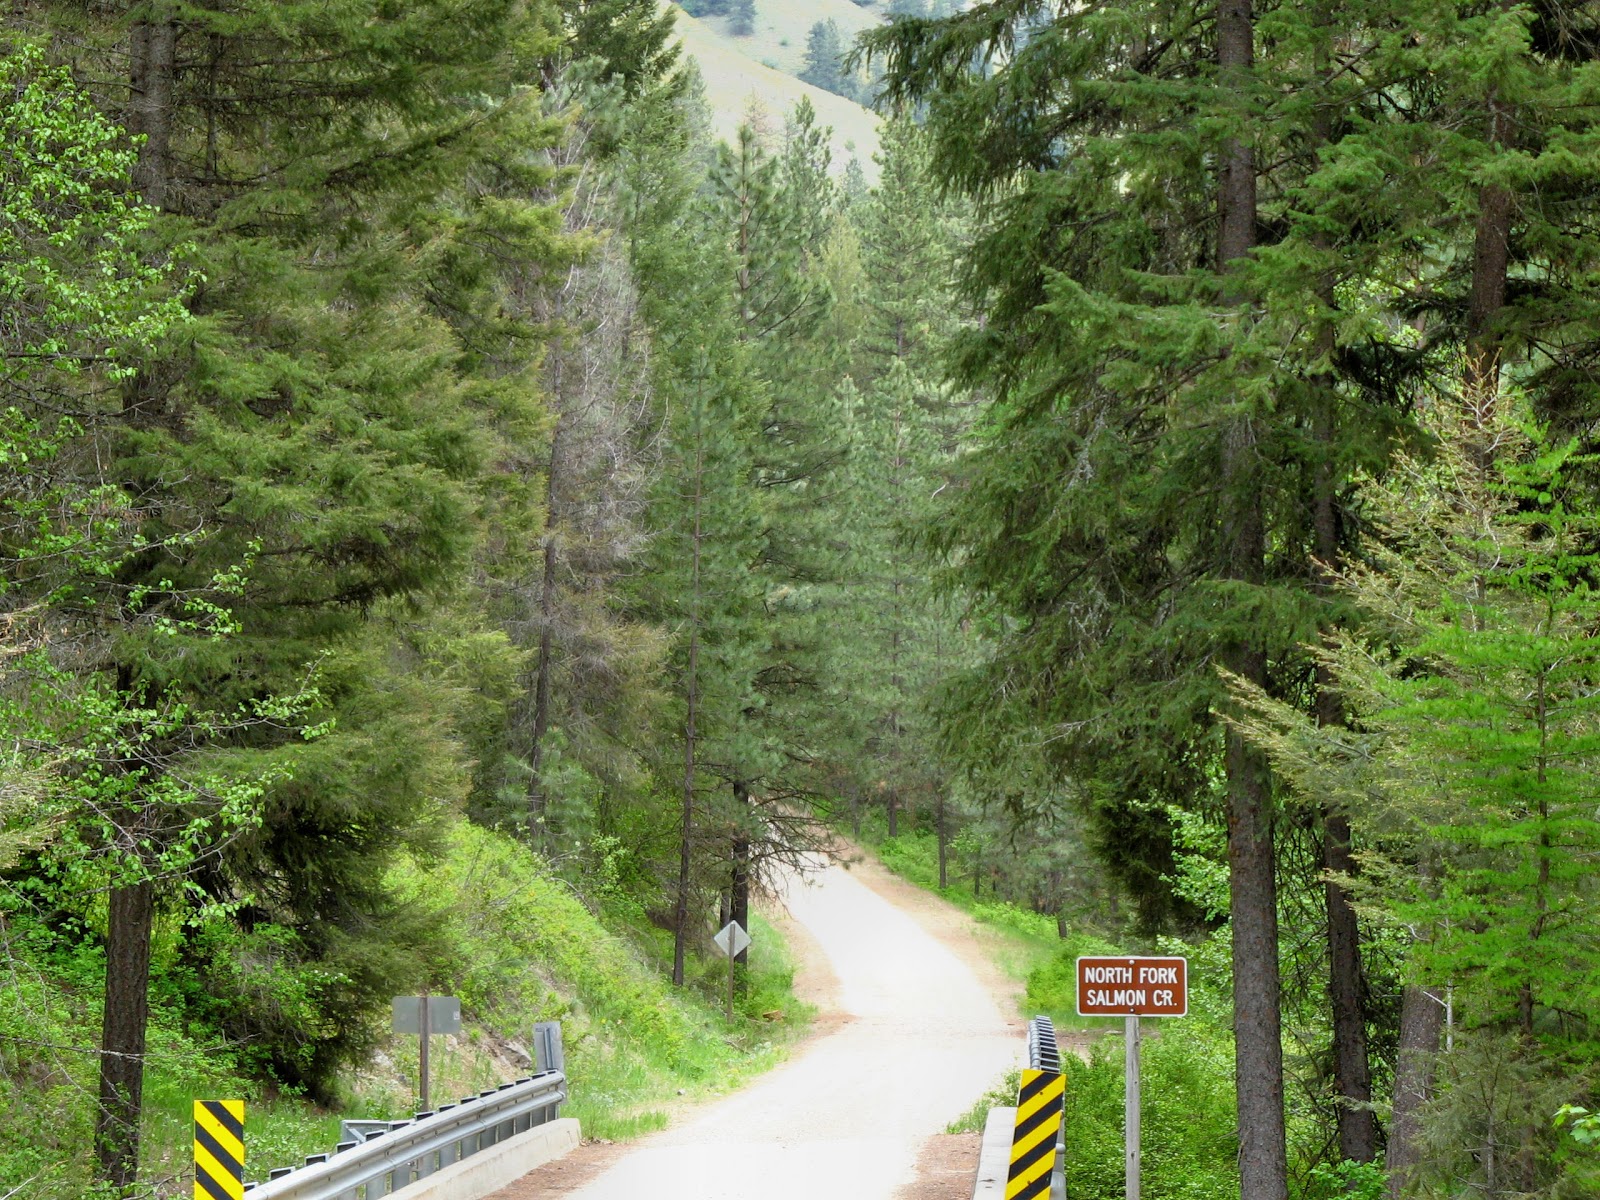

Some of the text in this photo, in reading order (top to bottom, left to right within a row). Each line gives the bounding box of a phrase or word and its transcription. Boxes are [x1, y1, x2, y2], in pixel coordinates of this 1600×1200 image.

[1085, 967, 1178, 984] NORTH FORK
[1087, 989, 1178, 1006] SALMON CR.
